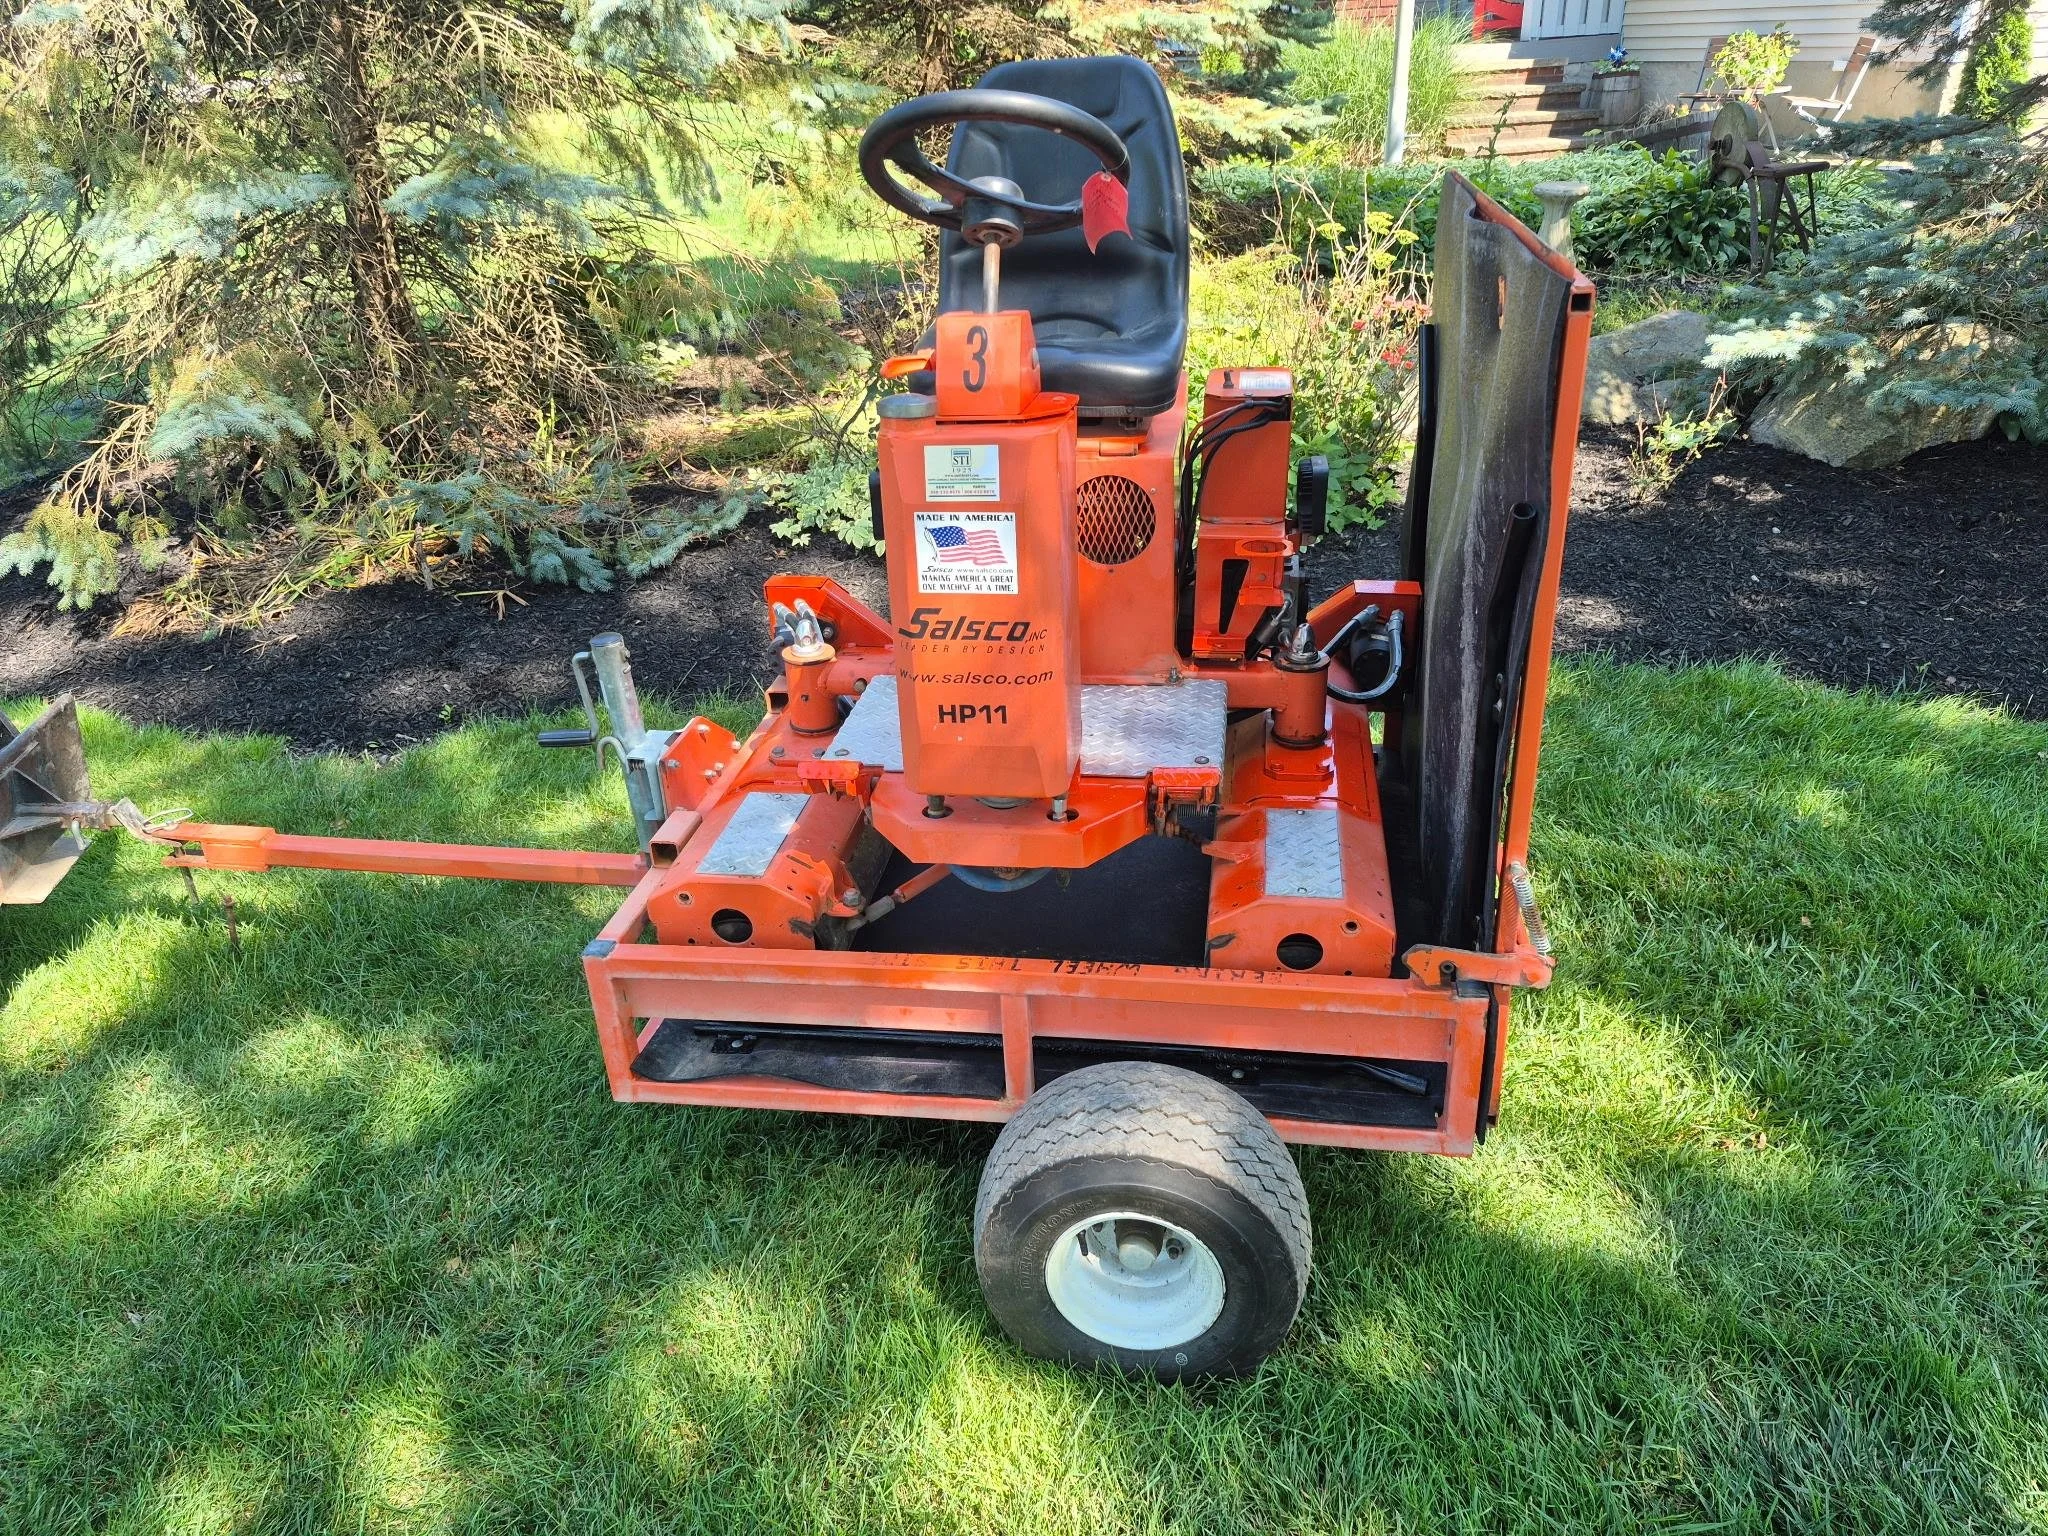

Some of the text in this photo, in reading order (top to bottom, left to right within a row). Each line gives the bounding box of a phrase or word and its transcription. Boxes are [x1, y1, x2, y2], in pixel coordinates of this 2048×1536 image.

[963, 325, 988, 393] 3
[953, 456, 969, 465] STI
[922, 565, 953, 573] Salsco
[922, 583, 936, 591] ONE
[940, 583, 971, 591] MACHINE
[995, 584, 1014, 592] TIME.
[900, 641, 1046, 654] LEADER BY DESIGN
[938, 704, 1008, 724] HP11
